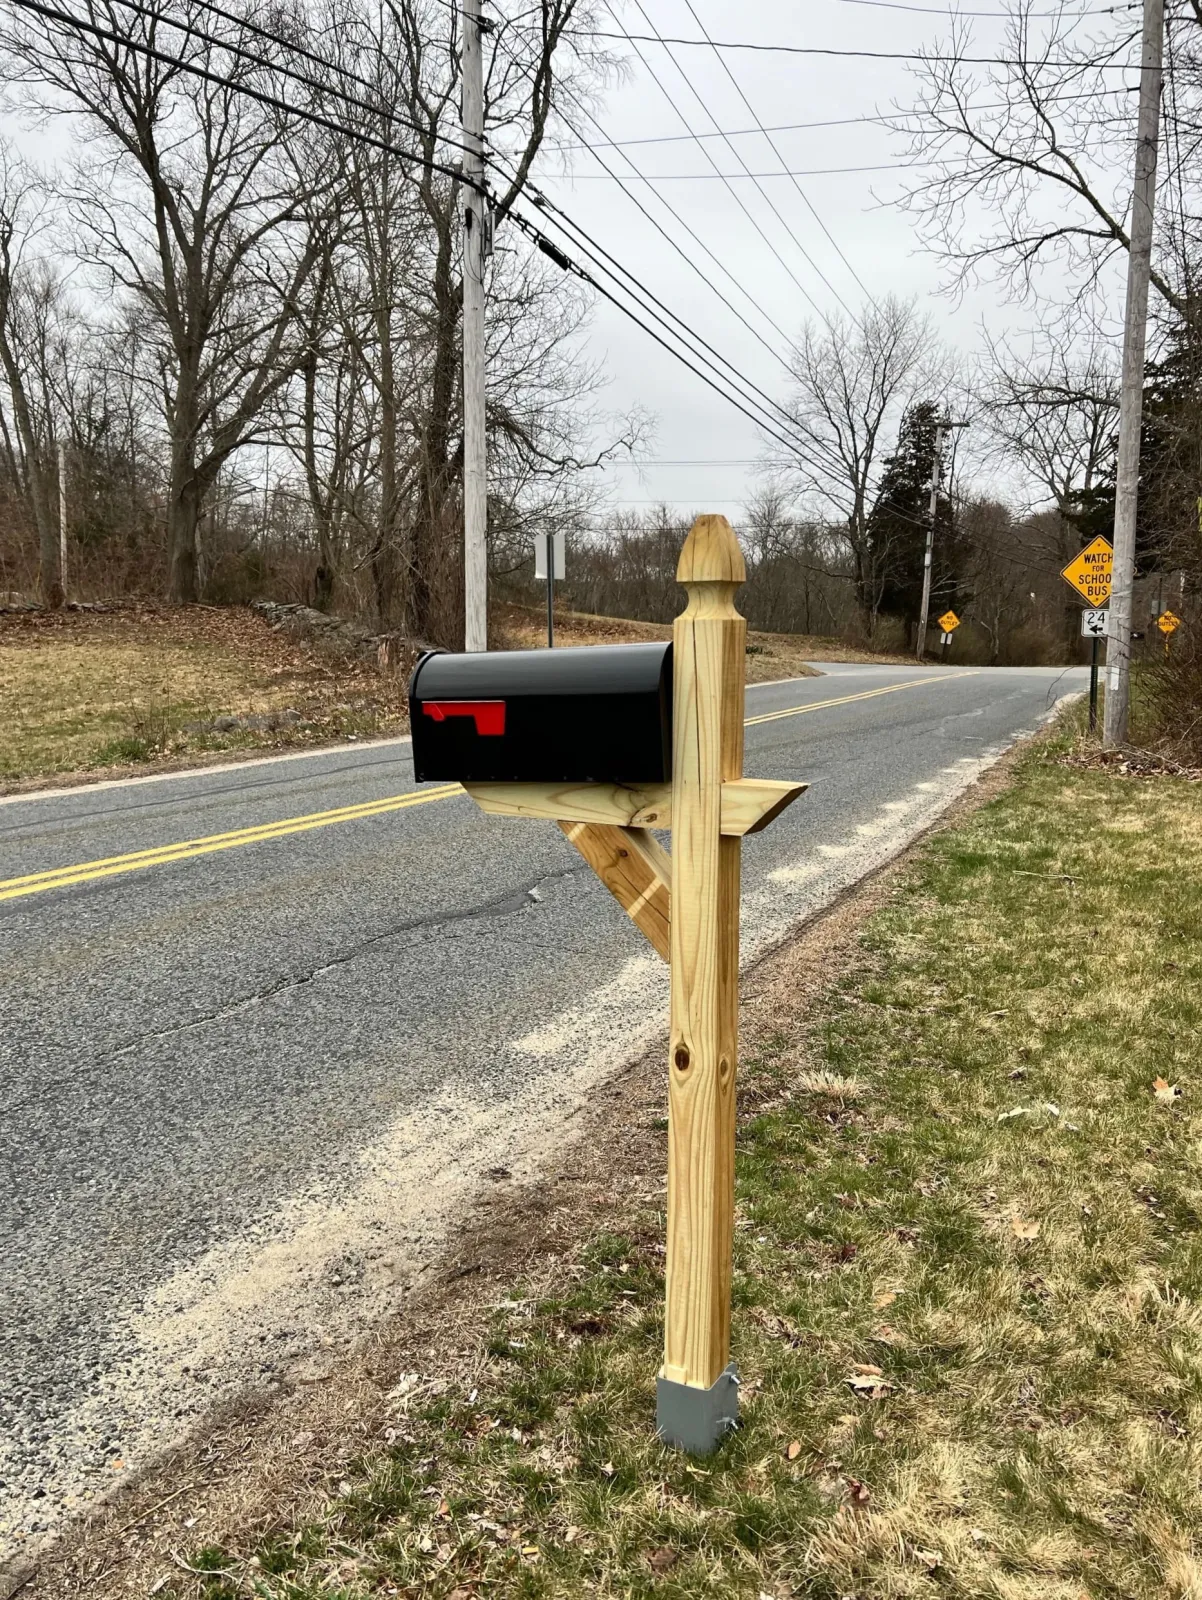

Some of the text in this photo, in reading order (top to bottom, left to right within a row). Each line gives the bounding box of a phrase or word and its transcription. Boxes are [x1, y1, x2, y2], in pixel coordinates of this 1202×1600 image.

[1084, 553, 1113, 564] WATCH
[1078, 573, 1112, 585] SCHOO
[1087, 586, 1108, 596] BUS
[1087, 612, 1105, 624] 24
